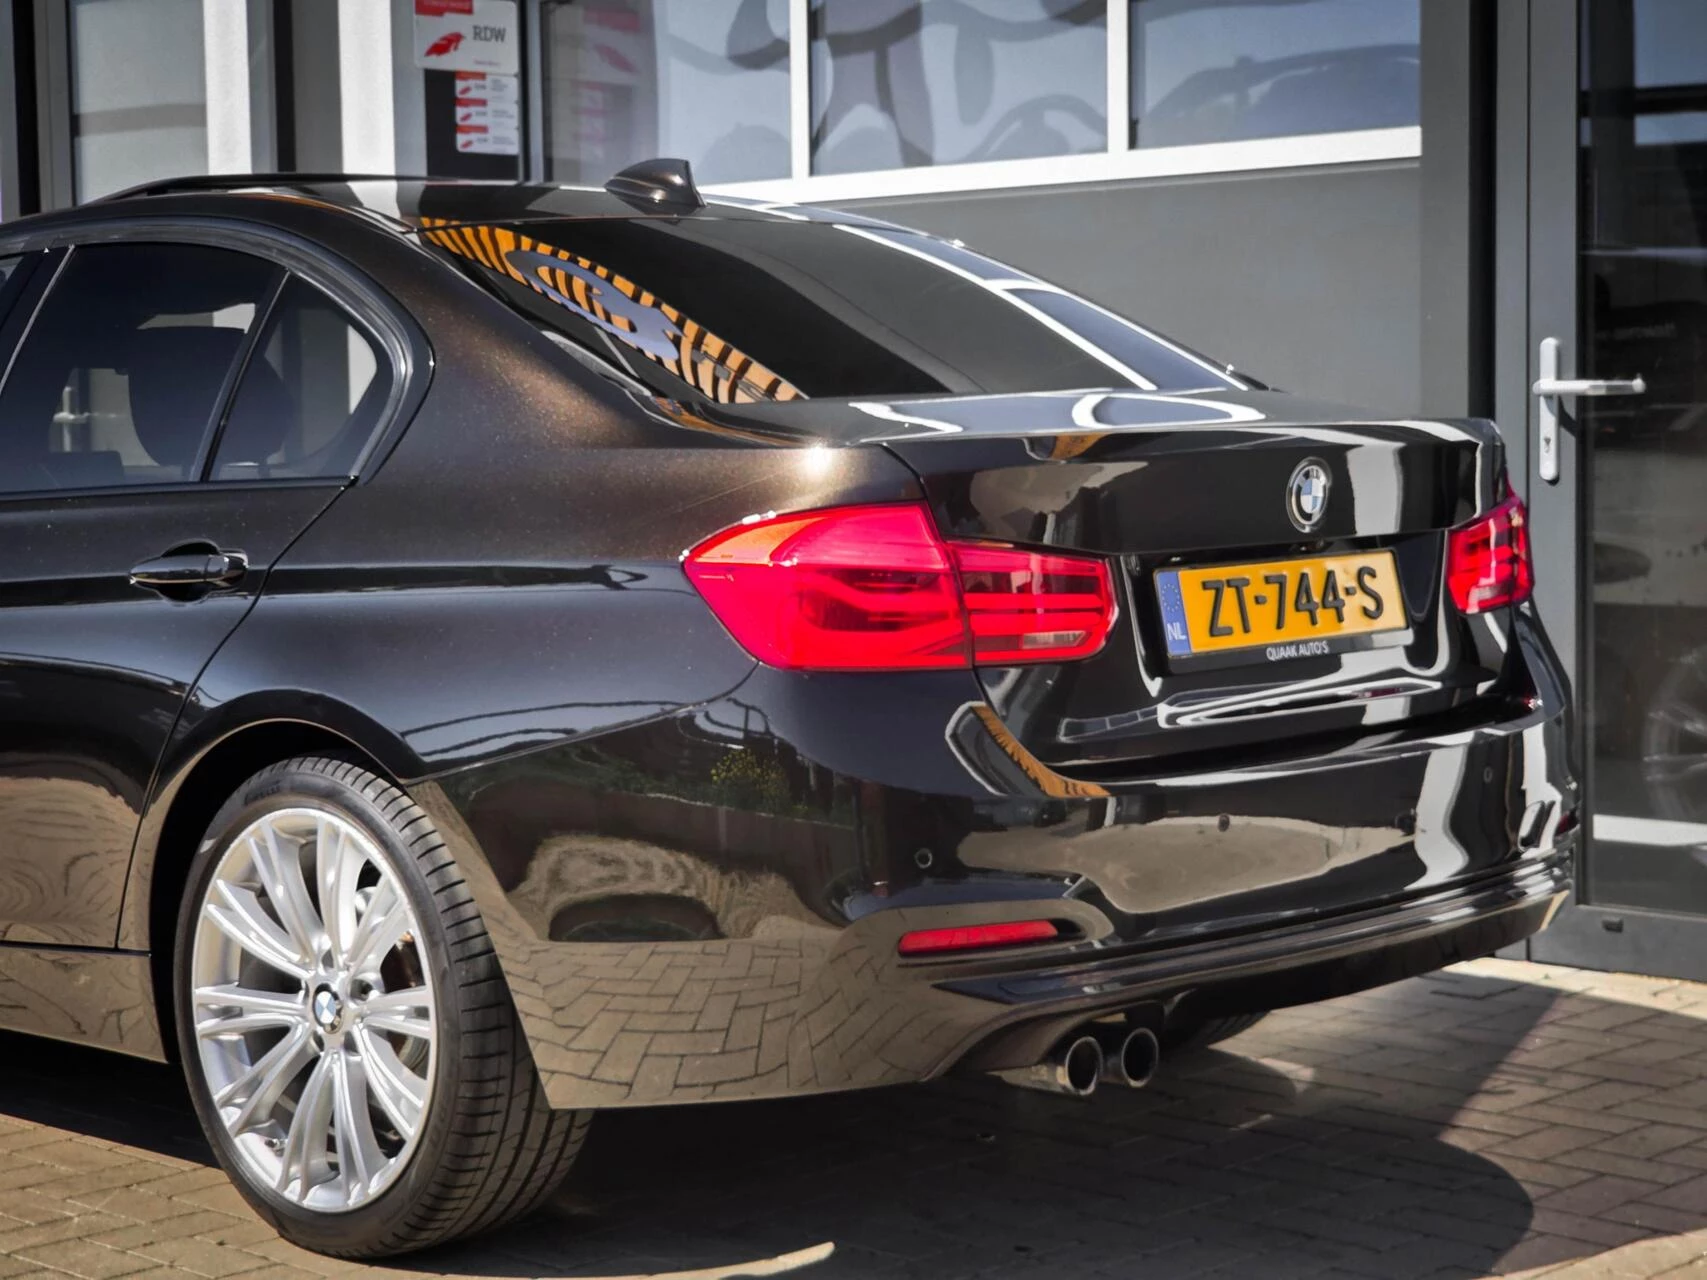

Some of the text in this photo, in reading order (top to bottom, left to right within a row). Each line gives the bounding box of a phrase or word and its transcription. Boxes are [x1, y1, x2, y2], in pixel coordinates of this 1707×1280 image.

[473, 25, 506, 42] RDW
[1201, 565, 1384, 637] ZT-744-S
[1166, 622, 1186, 640] NL
[1266, 640, 1329, 661] QUAAK AUTO'S
